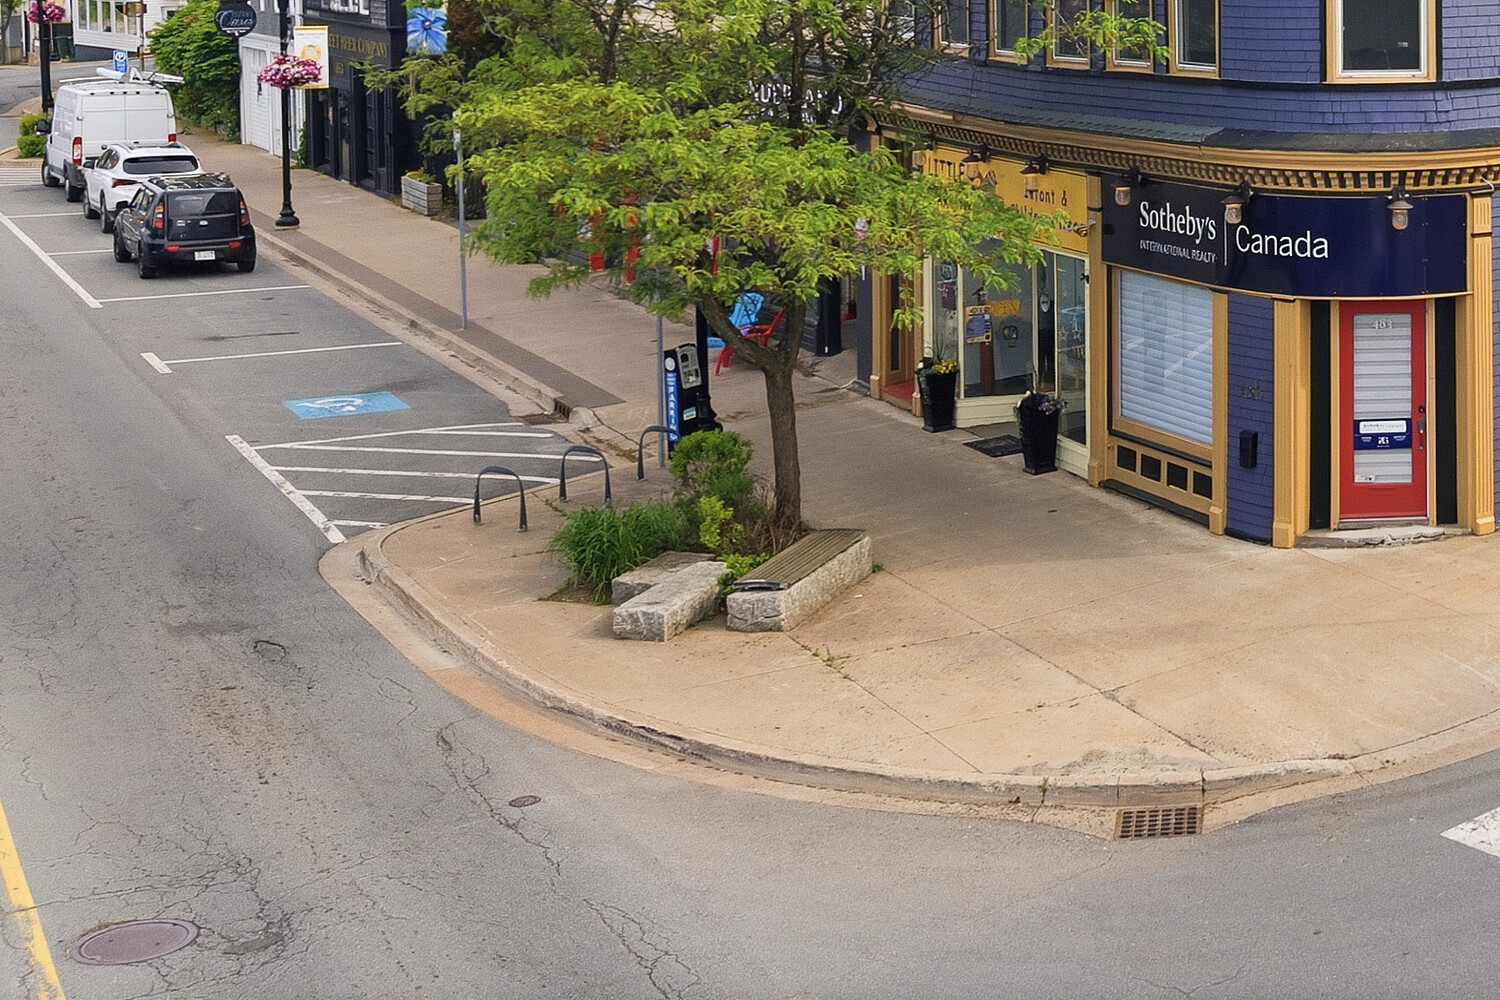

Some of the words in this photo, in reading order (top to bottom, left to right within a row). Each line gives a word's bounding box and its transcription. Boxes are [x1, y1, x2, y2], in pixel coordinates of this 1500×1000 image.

[1139, 201, 1216, 244] Sotheby's
[1235, 225, 1329, 259] Canada
[1140, 239, 1190, 260] INTERNATIONAL
[1191, 249, 1216, 264] REALTY
